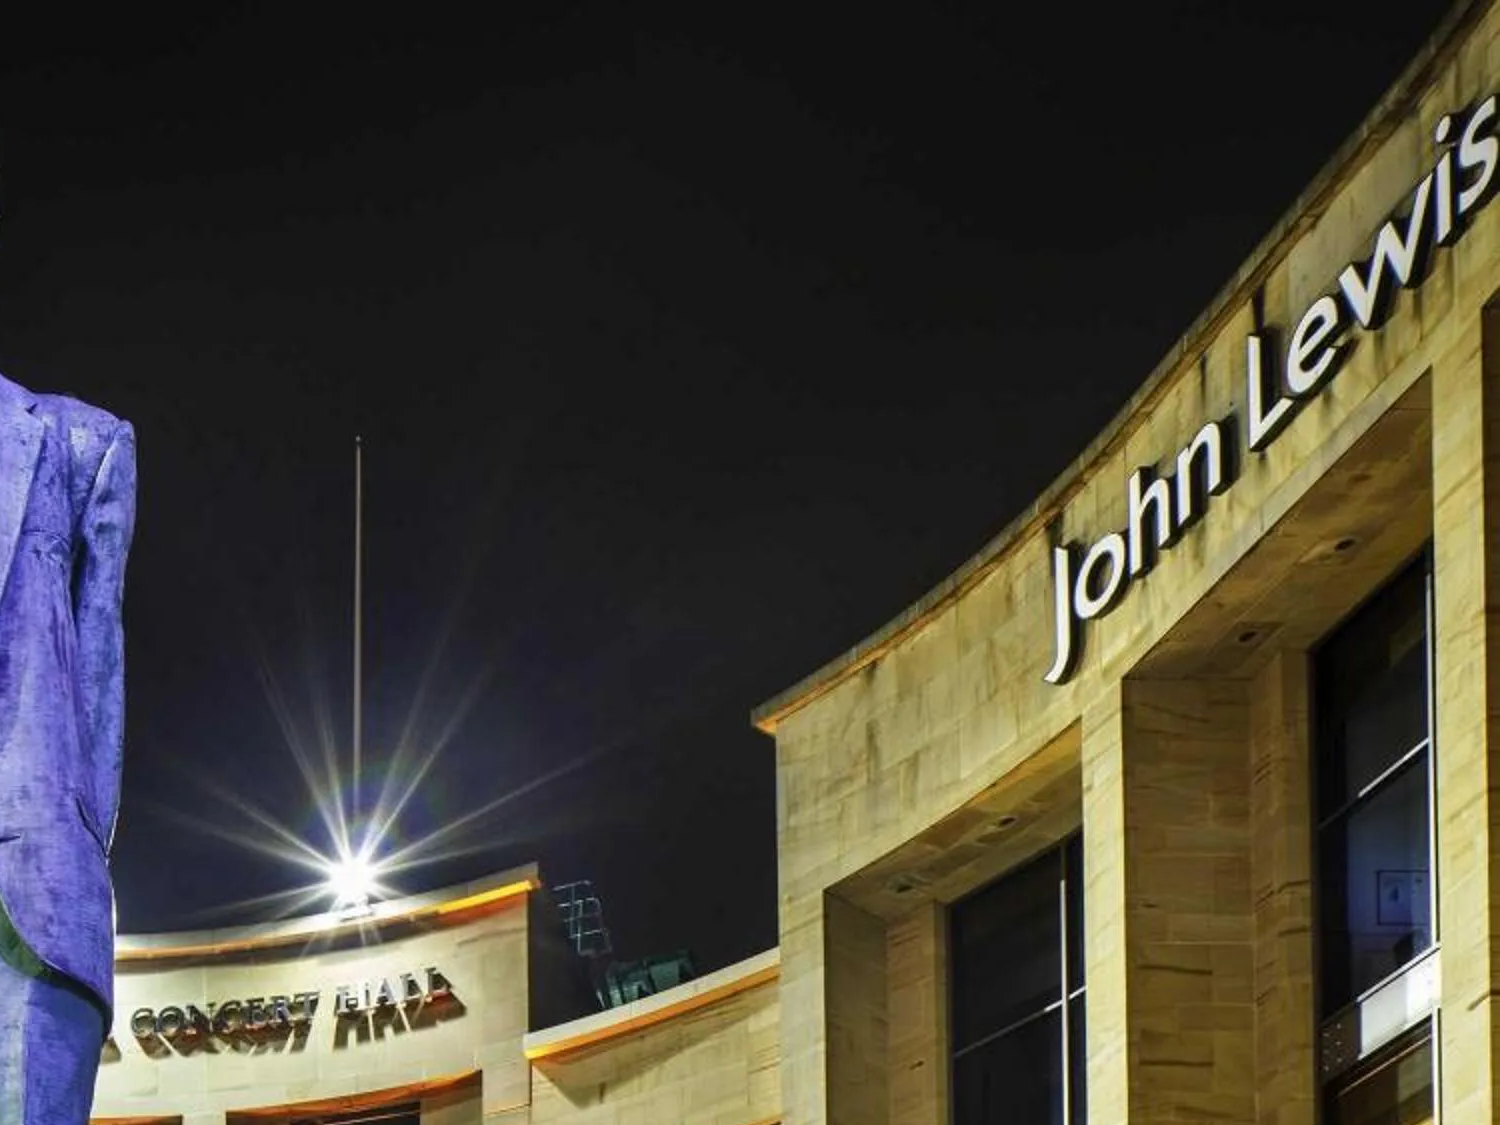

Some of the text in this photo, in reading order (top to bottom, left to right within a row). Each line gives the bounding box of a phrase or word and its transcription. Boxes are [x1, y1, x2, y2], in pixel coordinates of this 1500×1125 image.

[1044, 95, 1500, 684] John Lewis
[130, 966, 457, 1038] CONCERT HALL
